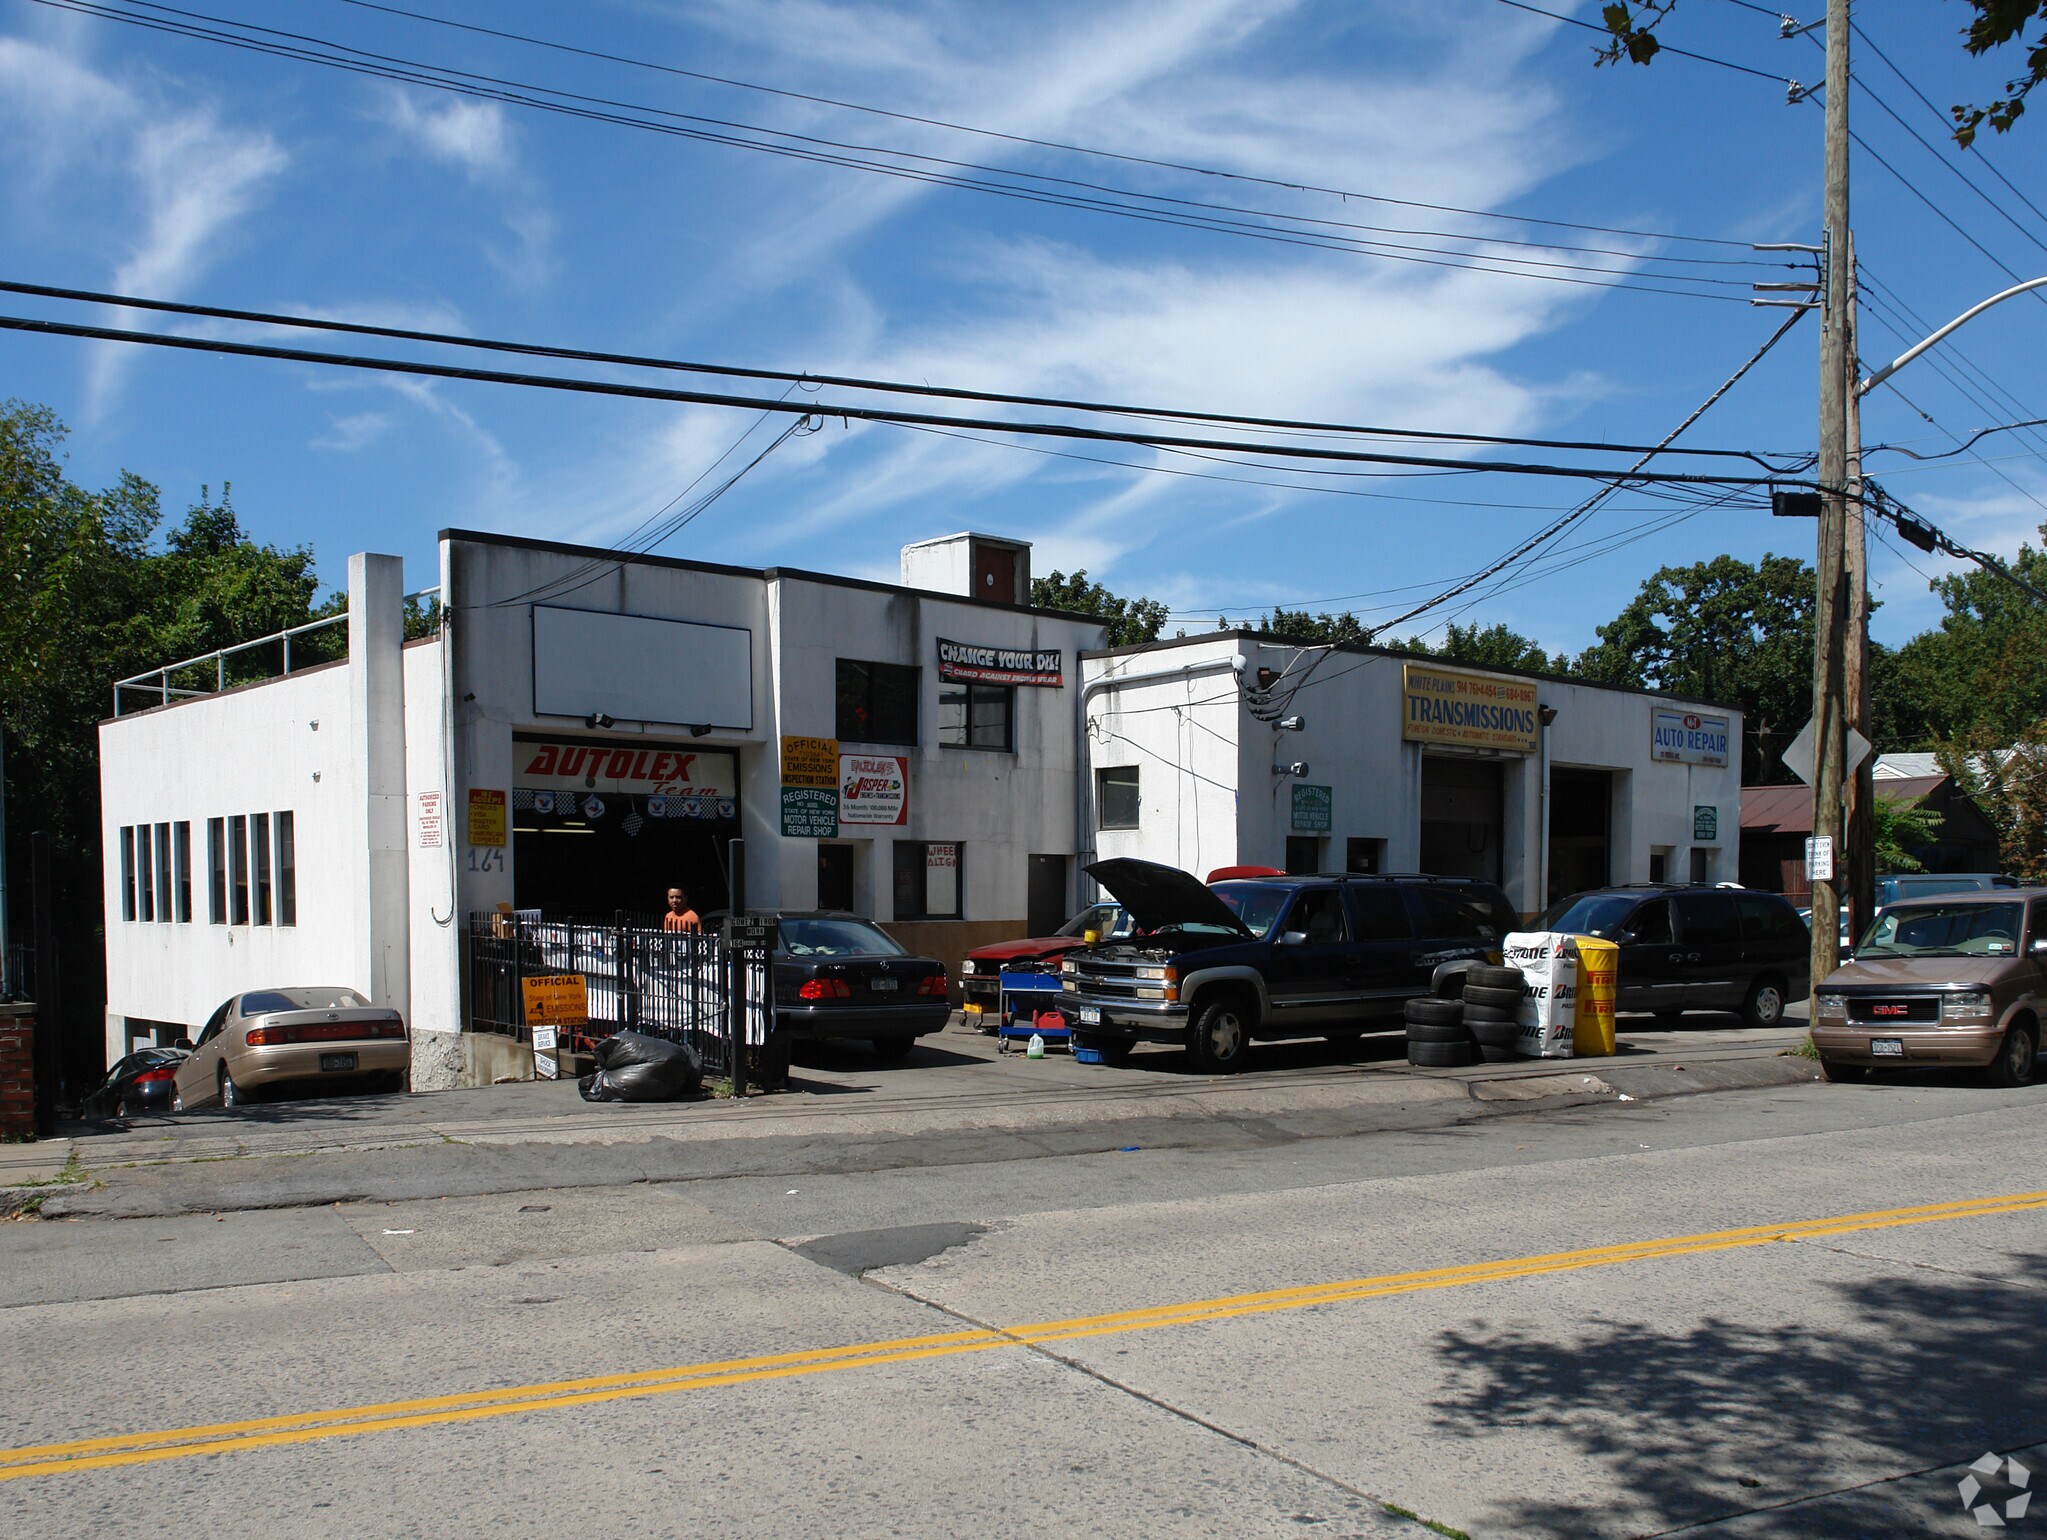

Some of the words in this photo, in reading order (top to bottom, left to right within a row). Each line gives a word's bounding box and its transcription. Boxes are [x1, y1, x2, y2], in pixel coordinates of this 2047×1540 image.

[940, 643, 996, 667] CHANGE
[998, 651, 1034, 670] YOUR
[1036, 654, 1060, 670] OIL!
[954, 668, 978, 678] GUARD
[980, 672, 1012, 680] AGAINST
[1408, 674, 1431, 690] WHITE
[1432, 678, 1456, 694] PLAINS
[1456, 680, 1468, 694] 914
[1408, 695, 1534, 734] TRANSMISSIONS
[1408, 724, 1430, 734] FOREIGN
[1432, 726, 1458, 737] DOMESTIC
[1462, 730, 1490, 740] AUTOMATIC
[1492, 733, 1516, 743] STANDARD
[1654, 727, 1684, 748] AUTO
[1688, 730, 1726, 752] REPAIR
[786, 740, 834, 756] OFFICIAL
[524, 746, 696, 782] AUTOLEX
[787, 762, 832, 773] EMISSIONS
[783, 774, 814, 784] INSPECTION
[815, 776, 836, 785] STATION
[652, 781, 718, 796] Team
[846, 777, 889, 799] JASPER
[1294, 787, 1329, 803] REGISTERED
[783, 790, 836, 806] REGISTERED
[784, 815, 807, 824] MOTOR
[809, 816, 835, 826] VEHICLE
[1310, 812, 1328, 820] VEHICLE
[787, 826, 811, 835] REPAIR
[813, 827, 832, 836] SHOP
[928, 846, 956, 856] WHEE
[468, 848, 504, 872] 164
[530, 977, 580, 987] OFFICIAL
[546, 1003, 585, 1014] EMISSIONS
[1872, 1005, 1908, 1015] GMC
[528, 1018, 562, 1026] INSPECTION
